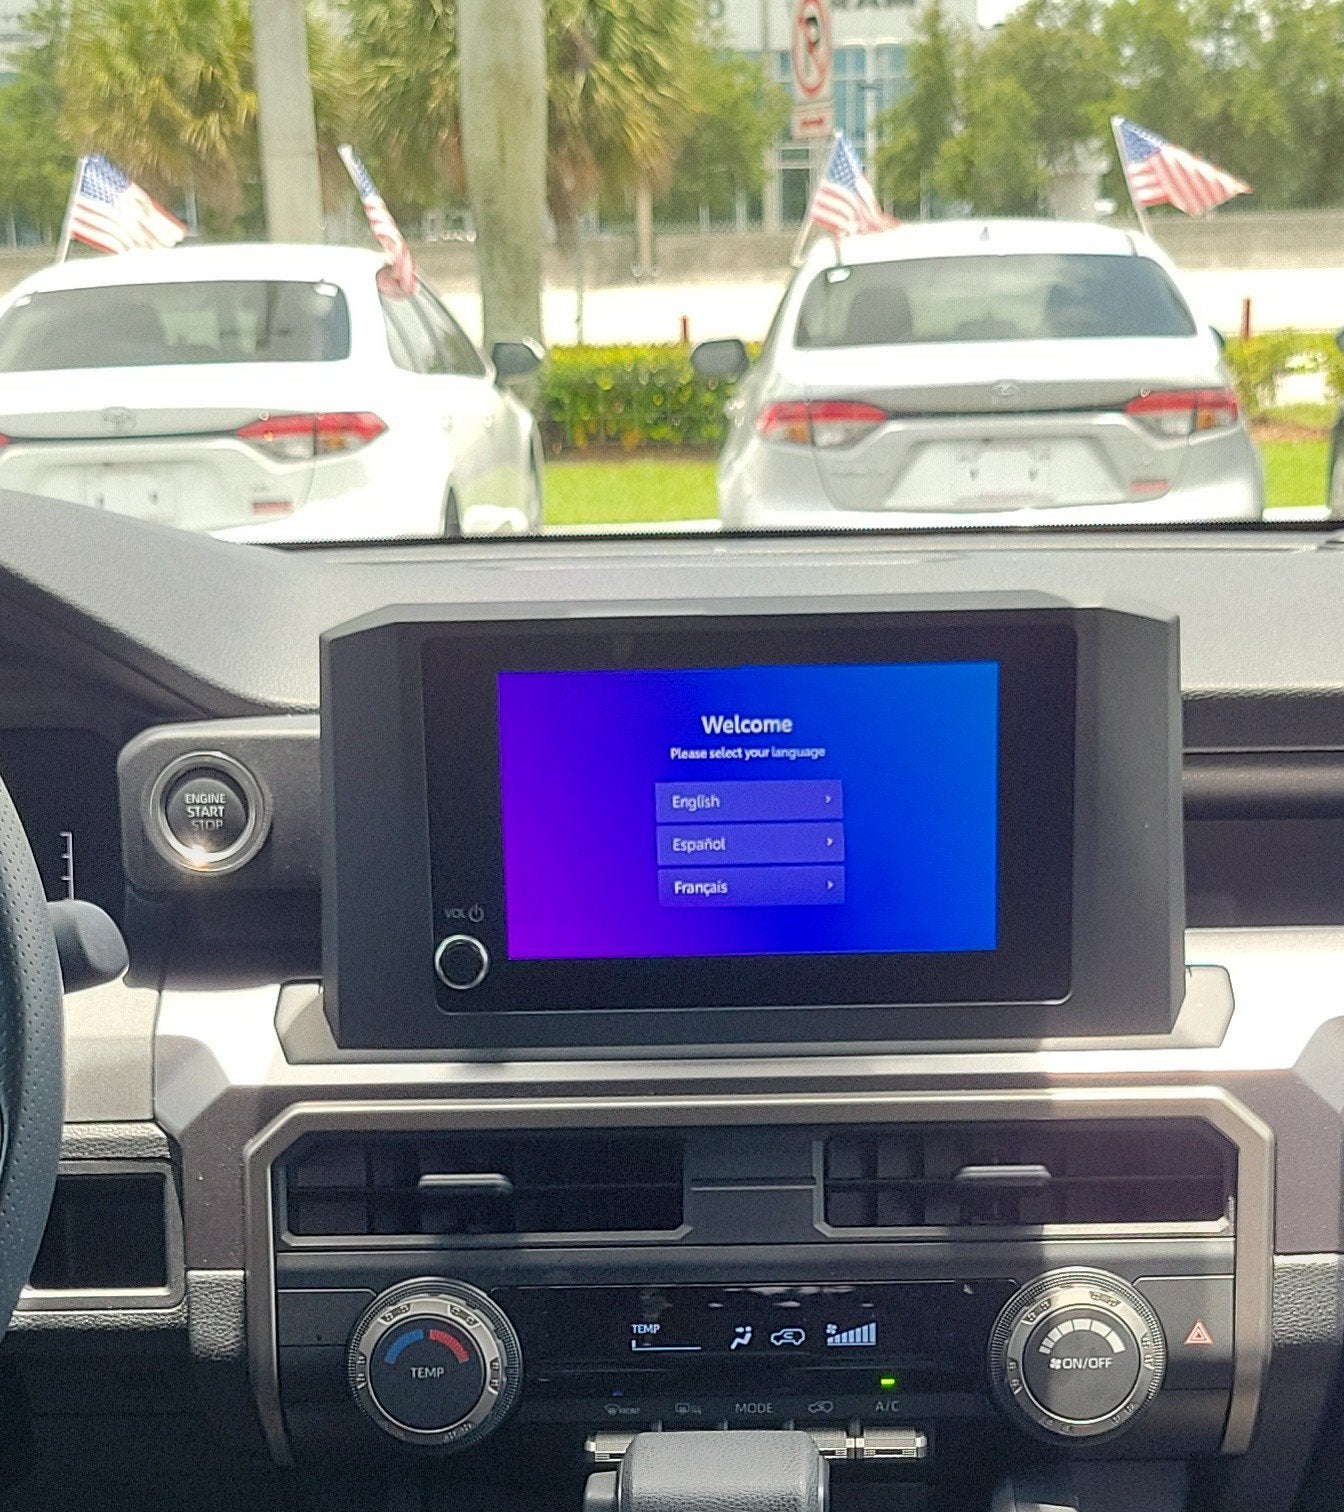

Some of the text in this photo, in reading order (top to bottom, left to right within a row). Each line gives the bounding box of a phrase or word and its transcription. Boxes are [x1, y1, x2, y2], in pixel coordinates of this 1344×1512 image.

[701, 714, 793, 734] Welcome
[670, 746, 826, 761] Please select your language
[184, 793, 226, 804] ENGINE
[672, 795, 720, 812] English
[186, 806, 225, 818] START
[191, 819, 224, 831] STOP
[672, 837, 726, 854] Español
[674, 880, 728, 897] Français
[630, 1323, 661, 1335] TEMP
[1062, 1358, 1112, 1370] ON/OFF
[410, 1367, 445, 1379] TEMP
[735, 1402, 774, 1414] MODE
[875, 1401, 900, 1412] A/C
